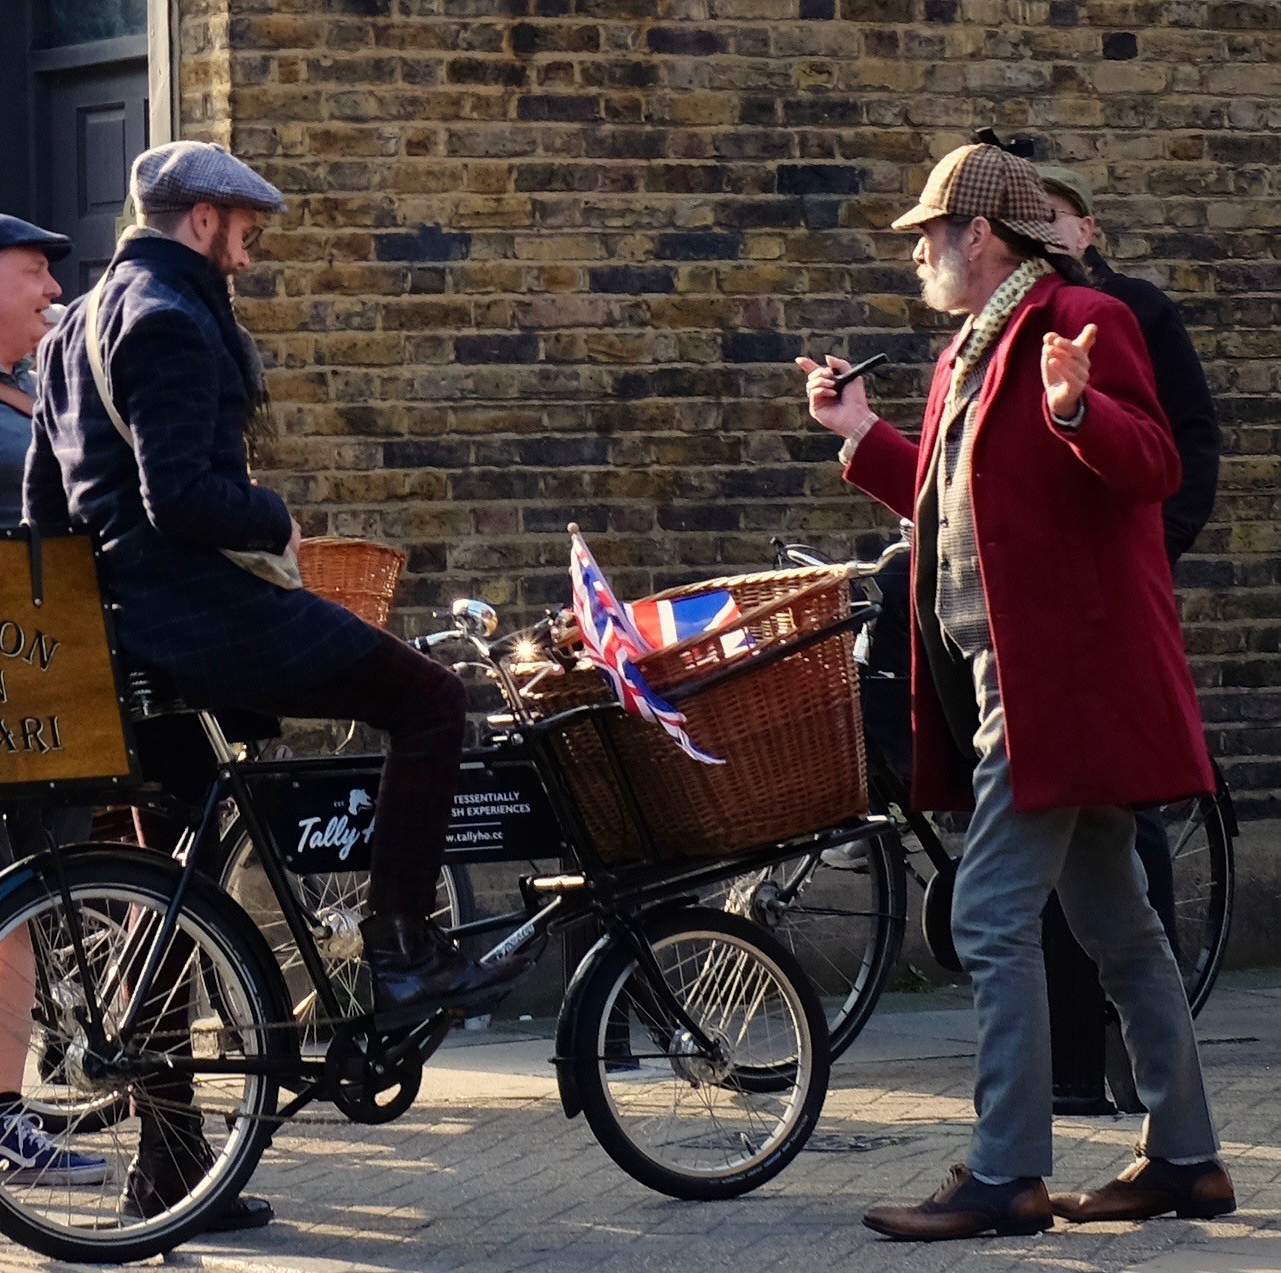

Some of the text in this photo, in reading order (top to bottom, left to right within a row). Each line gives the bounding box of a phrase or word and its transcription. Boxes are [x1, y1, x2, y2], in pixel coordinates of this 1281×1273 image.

[453, 791, 520, 805] TESSENTIALLY
[467, 803, 531, 817] EXPERIENCES
[297, 815, 360, 860] Tally
[445, 830, 503, 843] w.tallyho.cc
